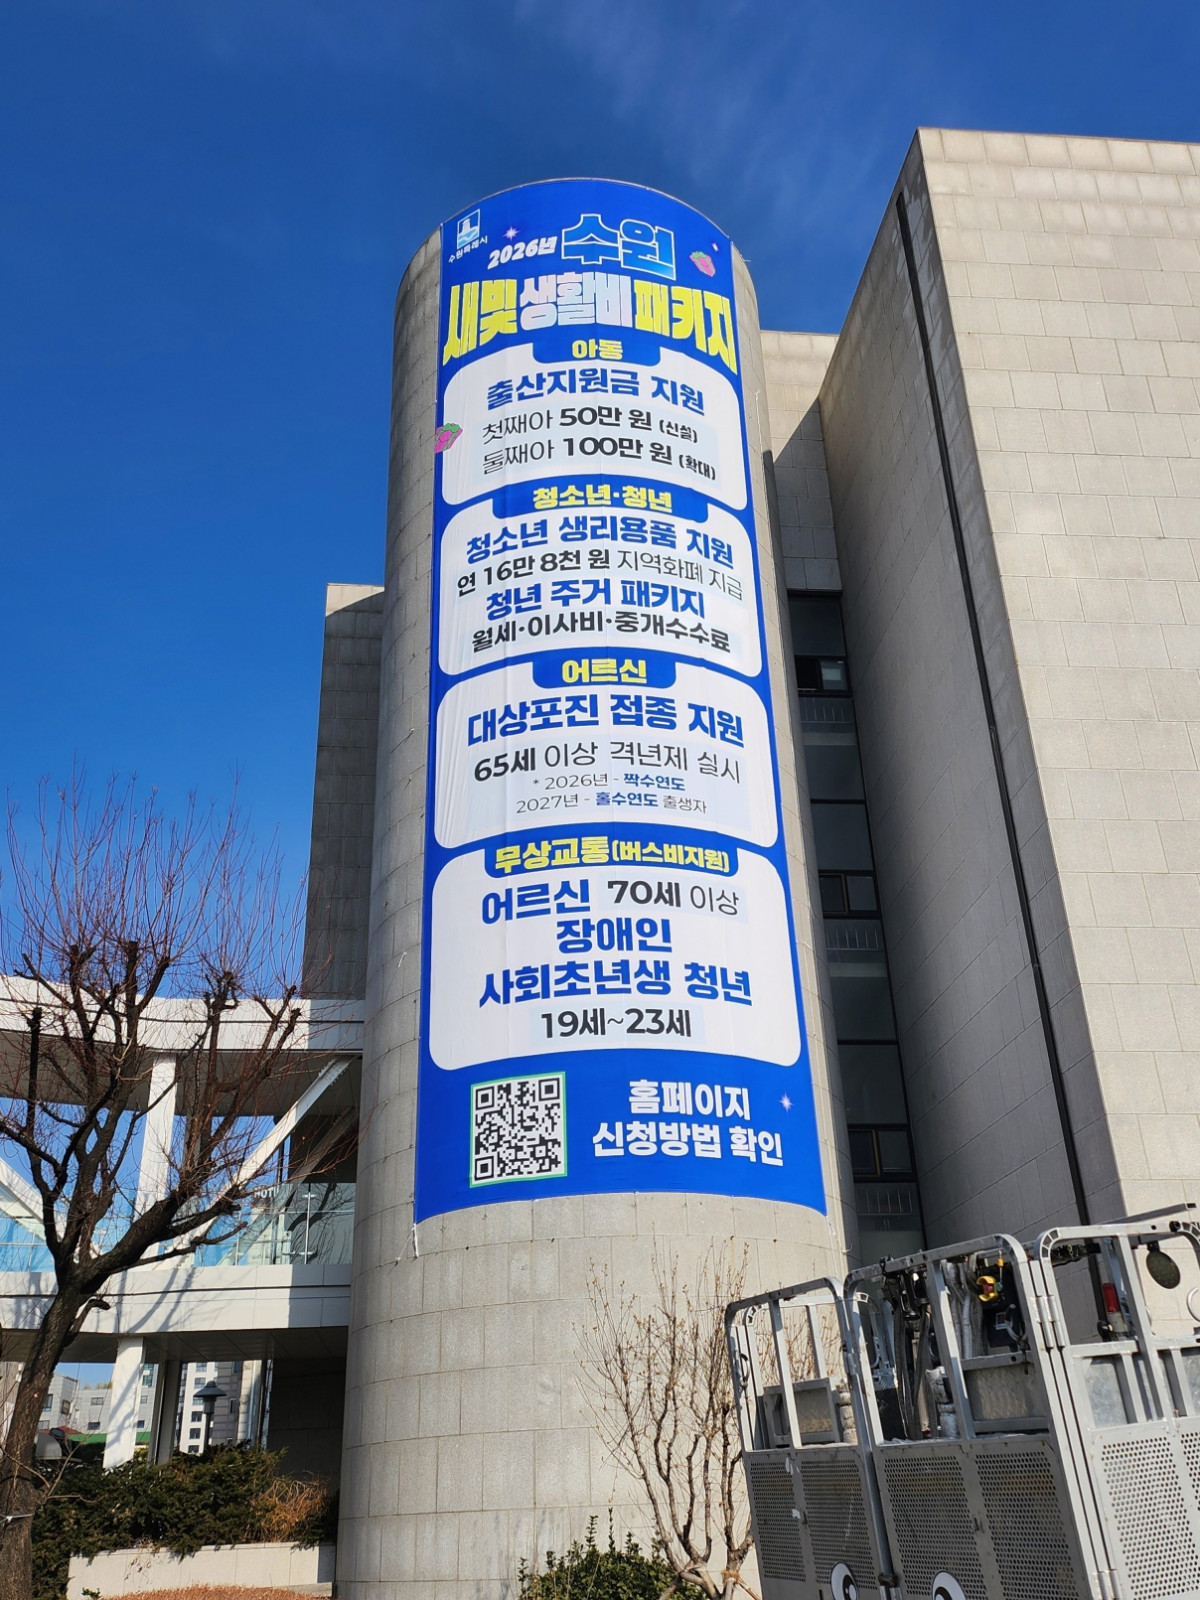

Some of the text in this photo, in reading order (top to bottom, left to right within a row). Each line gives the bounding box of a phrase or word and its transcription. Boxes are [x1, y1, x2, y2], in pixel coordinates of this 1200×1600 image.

[487, 213, 676, 280] 2026년 수원
[572, 339, 623, 360] 아동
[487, 367, 705, 416] 출산지원금 지원
[482, 405, 697, 445] 첫째아 50만 원 (신설)
[483, 437, 716, 480] 둘째아 100만 원 (확대)
[532, 484, 672, 513] 청소년·청년
[467, 516, 733, 570] 청소년 생리용품 지원
[457, 549, 743, 601] 연 16만 8천 원 지역화폐 지급
[486, 579, 705, 621] 청년 주거 패키지
[472, 611, 730, 653] 월세·이사비·중개수수료
[561, 658, 648, 685] 어르신
[468, 694, 744, 748] 대상포진 접종 지원
[474, 741, 741, 784] 65세 이상 격년제 실시
[544, 772, 685, 791] 2026년 짝수연도
[516, 791, 707, 815] 2027년 홀수연도 출생자
[481, 878, 739, 925] 어르신 70세 이상
[556, 917, 672, 954] 장애인
[479, 959, 753, 1008] 사회초년생 청년
[541, 1007, 692, 1039] 19세~23세
[628, 1079, 751, 1121] 홈페이지
[592, 1121, 785, 1167] 신청방법 확인
